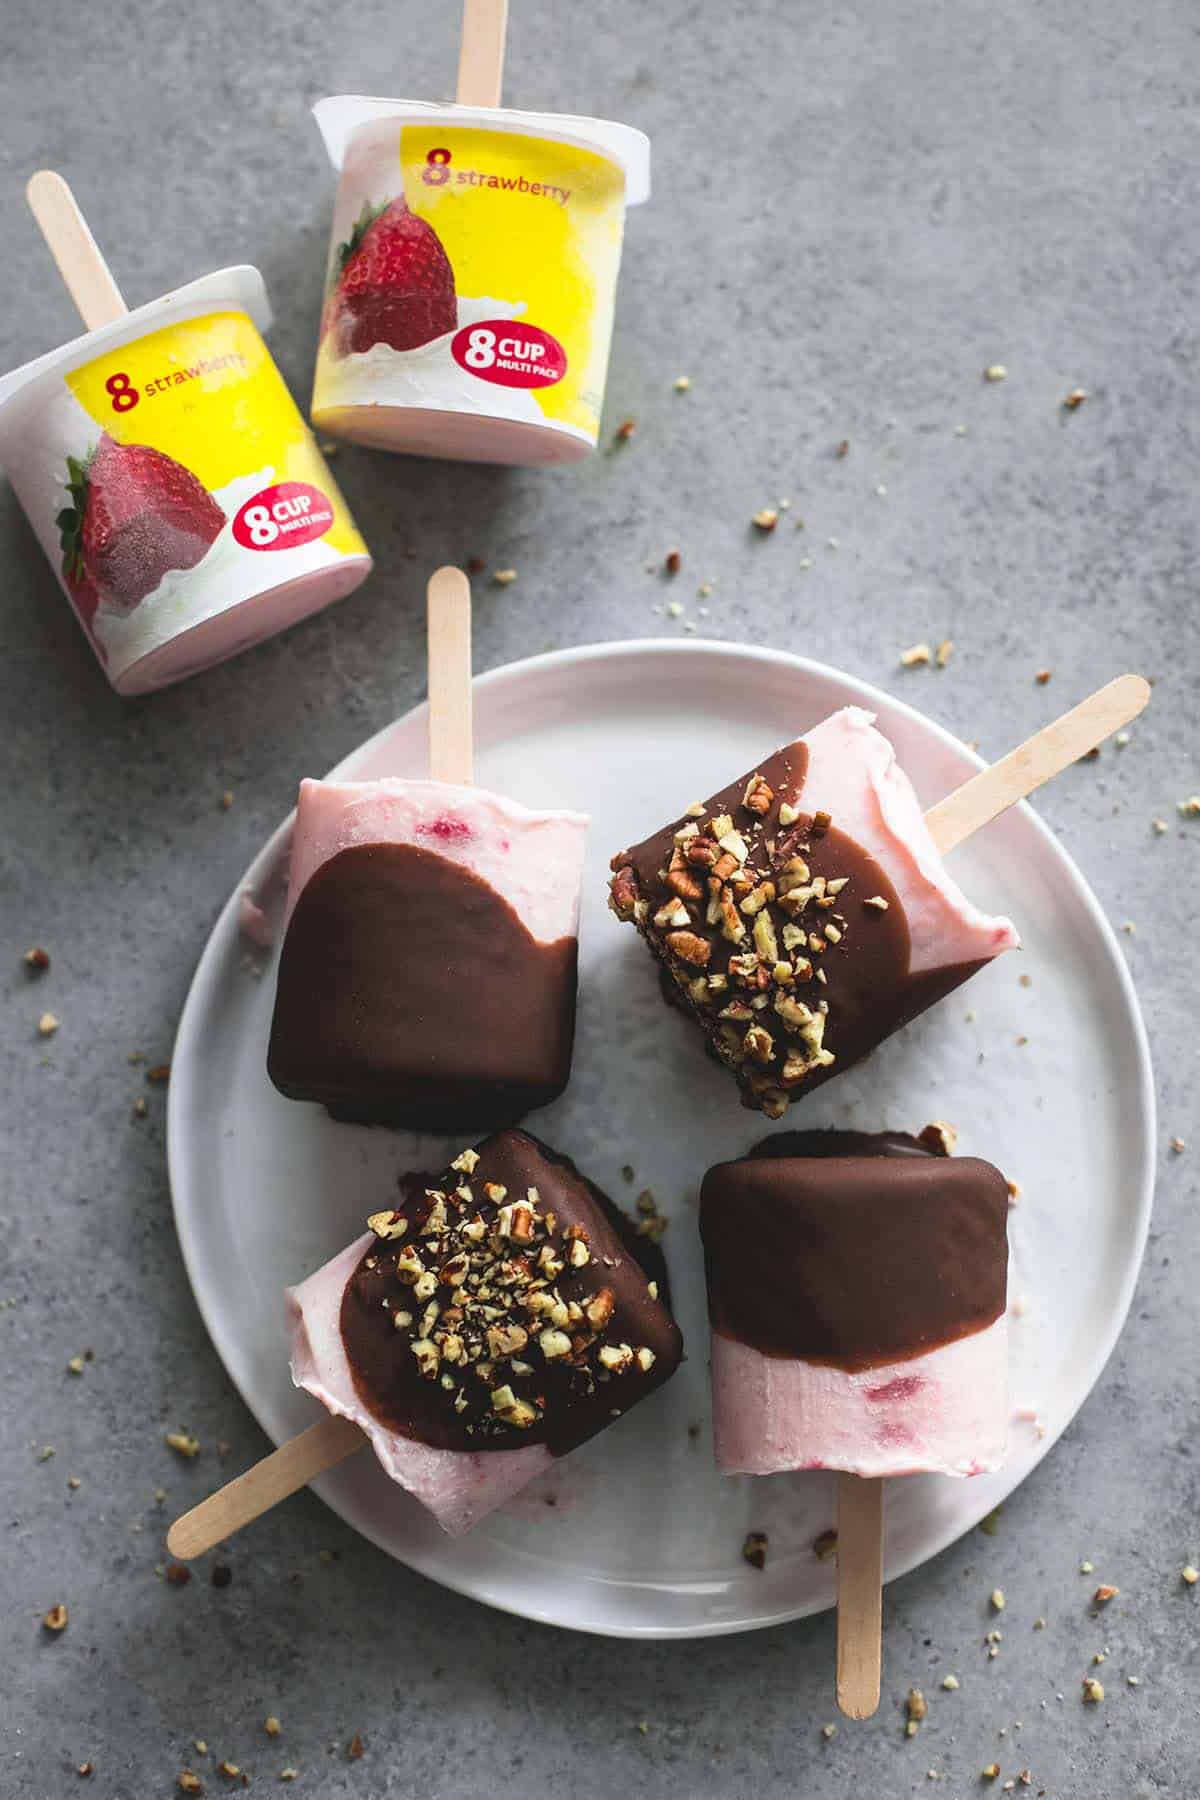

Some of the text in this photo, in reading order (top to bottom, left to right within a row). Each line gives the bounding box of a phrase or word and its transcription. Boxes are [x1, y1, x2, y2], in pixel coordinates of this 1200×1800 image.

[422, 148, 571, 207] 8 strawberry
[465, 329, 545, 369] 8 CUP
[496, 358, 560, 380] MULTI PACK
[105, 351, 247, 413] 8 strawberry
[244, 495, 312, 545] 8 CUP
